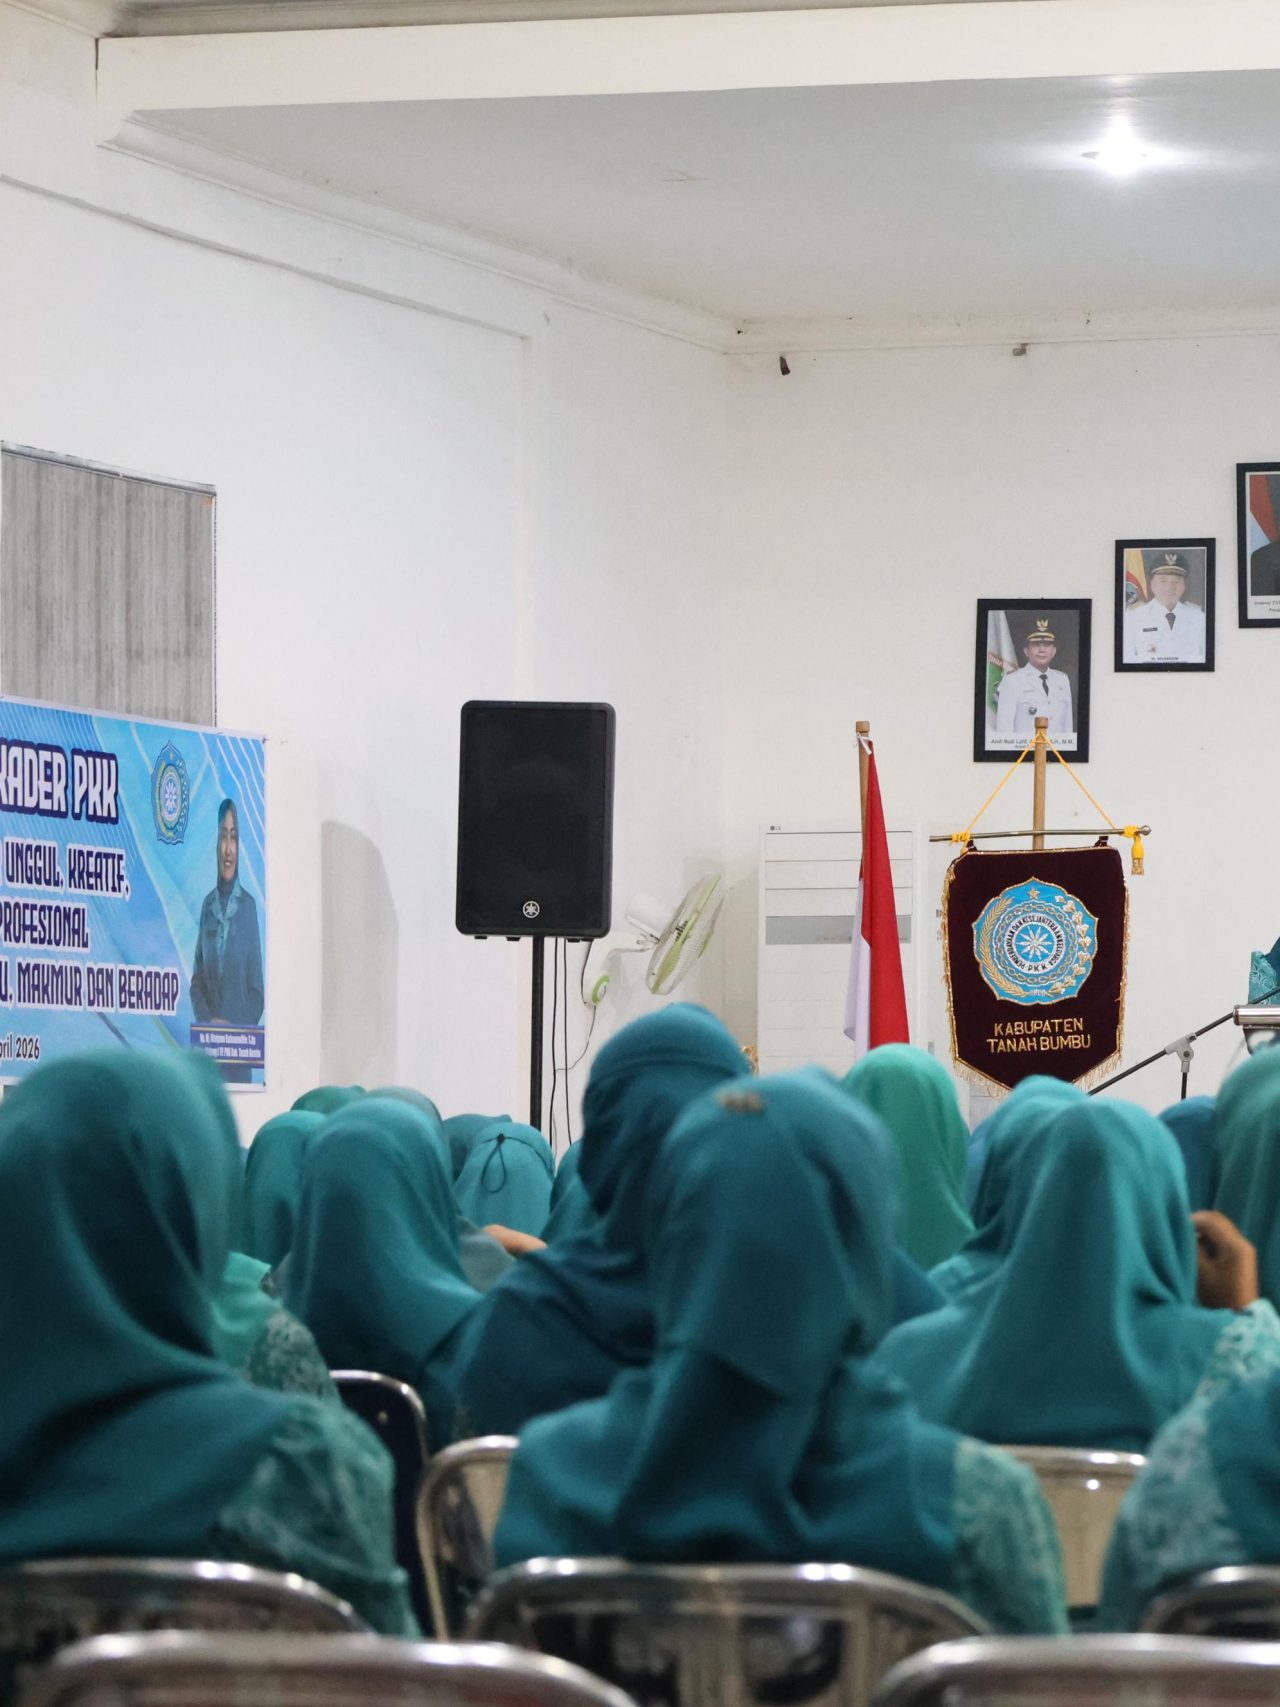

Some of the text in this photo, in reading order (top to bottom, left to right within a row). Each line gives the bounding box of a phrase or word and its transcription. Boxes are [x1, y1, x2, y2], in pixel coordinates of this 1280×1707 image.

[73, 754, 117, 818] PKK
[6, 841, 129, 895] UNGGUL, KREATIF,
[17, 962, 82, 1006] MAKMUR
[87, 967, 114, 1008] DAN
[119, 969, 179, 1012] BERADAP
[987, 1034, 1091, 1053] TANAH BUMBU
[994, 1018, 1083, 1036] KABUPATEN
[16, 1037, 40, 1060] 2026
